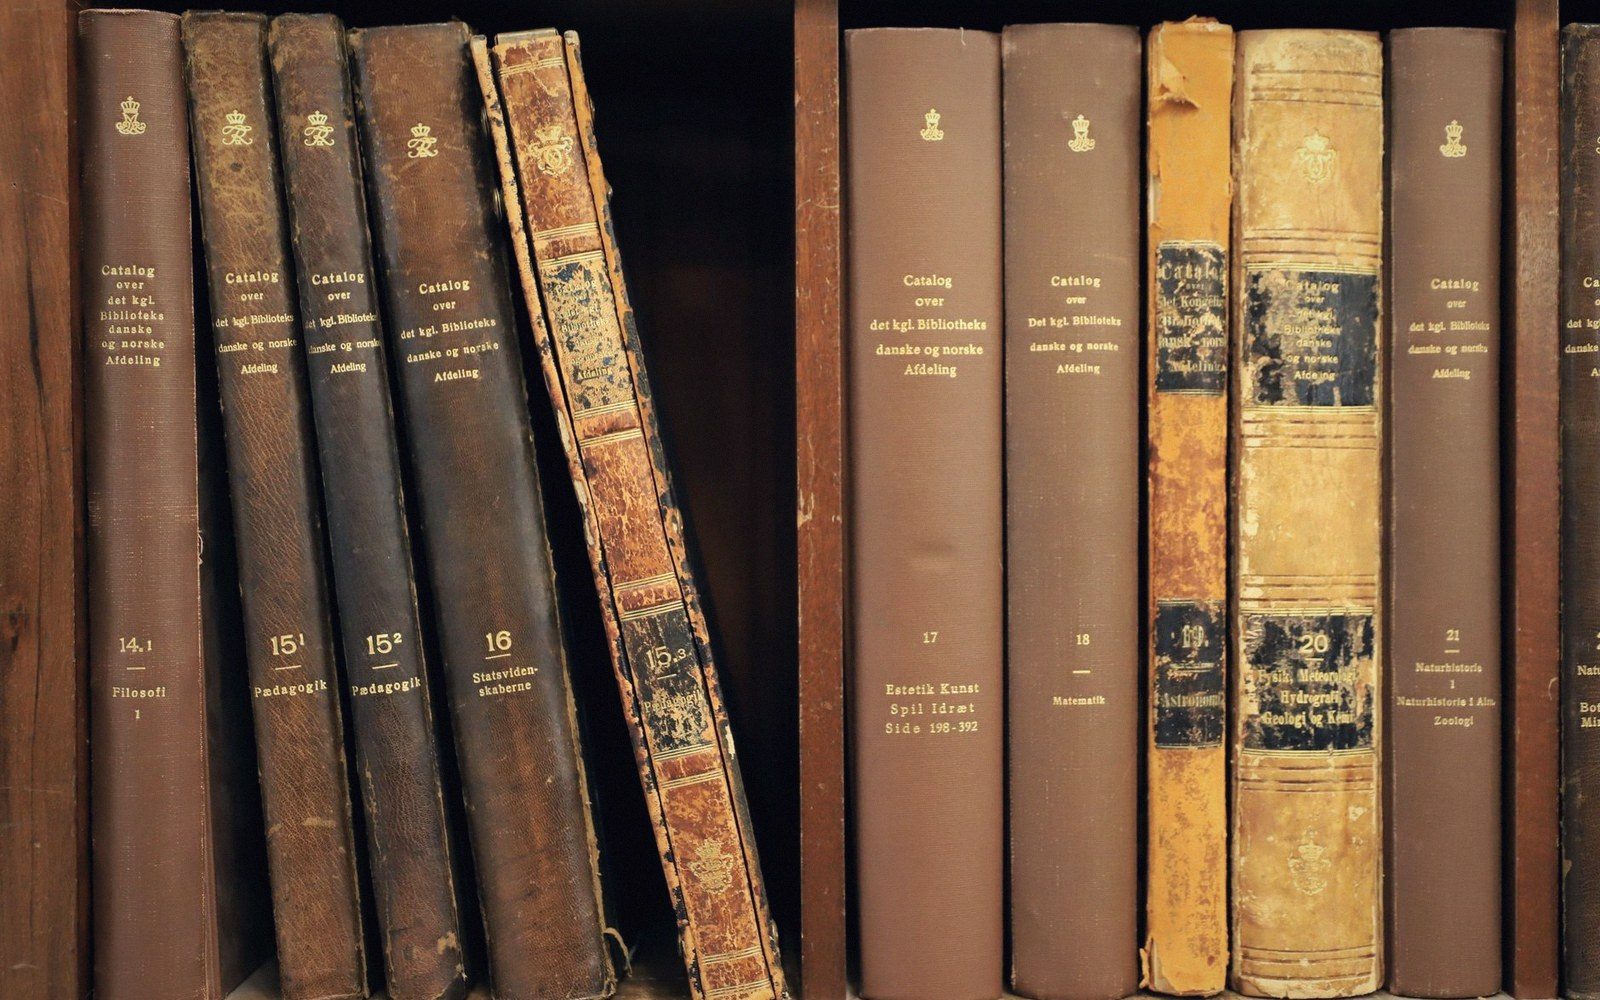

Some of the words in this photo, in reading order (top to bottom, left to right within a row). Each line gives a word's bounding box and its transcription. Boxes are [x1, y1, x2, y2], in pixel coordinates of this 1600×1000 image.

[102, 265, 155, 277] Catalog
[225, 272, 279, 284] Catalog
[311, 272, 365, 285] Catalog
[903, 275, 952, 289] Catalog
[1051, 275, 1101, 288] Catalog
[116, 281, 144, 289] over
[419, 279, 470, 295] Catalog
[1431, 278, 1479, 291] Catalog
[108, 297, 126, 305] det
[241, 292, 264, 301] over
[328, 292, 351, 301] over
[915, 297, 944, 307] over
[1304, 296, 1325, 304] over
[433, 301, 456, 311] over
[1446, 300, 1467, 308] over
[100, 311, 164, 321] Biblioteks
[215, 318, 229, 327] det
[250, 313, 294, 324] Biblioteks
[320, 316, 337, 328] kgl.
[1028, 317, 1046, 327] Det
[1072, 316, 1122, 326] Biblioteks
[109, 325, 152, 334] danske
[401, 329, 415, 340] det
[419, 325, 439, 338] kgl.
[442, 319, 496, 333] Biblioteks
[870, 319, 889, 331] det
[893, 319, 915, 333] kgl.
[918, 319, 987, 331] Bibliotheks
[1409, 322, 1424, 331] det
[1450, 321, 1490, 331] Biblioteks
[1567, 319, 1582, 329] det
[102, 340, 115, 349] og
[122, 340, 165, 349] norske
[219, 342, 248, 352] danske
[252, 342, 264, 351] og
[269, 338, 297, 348] norske
[341, 342, 352, 352] og
[1030, 342, 1066, 352] danske
[1070, 343, 1083, 353] og
[1087, 342, 1119, 351] norske
[1408, 345, 1441, 354] danske
[1445, 345, 1458, 355] og
[1565, 343, 1599, 353] danske
[407, 350, 442, 364] danske
[446, 348, 459, 358] og
[463, 342, 499, 355] norske
[876, 344, 921, 355] danske
[924, 346, 940, 358] og
[943, 344, 984, 355] norske
[105, 355, 161, 366] Afdeling
[1304, 355, 1339, 364] norske
[241, 363, 278, 374] Afdeling
[330, 362, 367, 374] Afdeling
[904, 363, 957, 378] Afdeling
[1056, 364, 1101, 375] Afdeling
[1432, 368, 1471, 380] Afdeling
[434, 369, 479, 383] Afdeling
[1294, 370, 1336, 381] Afdeling
[486, 630, 512, 652] 16
[923, 631, 938, 643] 17
[1076, 634, 1090, 646] 18
[1446, 630, 1460, 641] 21
[1300, 634, 1329, 653] 20
[1415, 662, 1482, 672] Naturhistorie
[472, 666, 538, 684] Statsviden-
[112, 686, 166, 698] Filosofi
[255, 680, 328, 698] Pædagogik
[352, 676, 421, 696] Pædagogik
[479, 681, 532, 697] skaberne
[885, 683, 935, 695] Estetik
[940, 682, 980, 695] Kunst
[1053, 695, 1106, 706] Matematik
[1281, 690, 1340, 707] Hydrografi
[1396, 696, 1466, 707] Naturhistorie
[135, 709, 141, 719] 1
[891, 703, 924, 718] Spil
[932, 703, 975, 714] Idræt
[1261, 711, 1306, 728] Geologi
[1311, 714, 1324, 728] og
[1434, 716, 1474, 727] Zoologi
[885, 722, 921, 734] Side
[929, 721, 978, 733] 198-392
